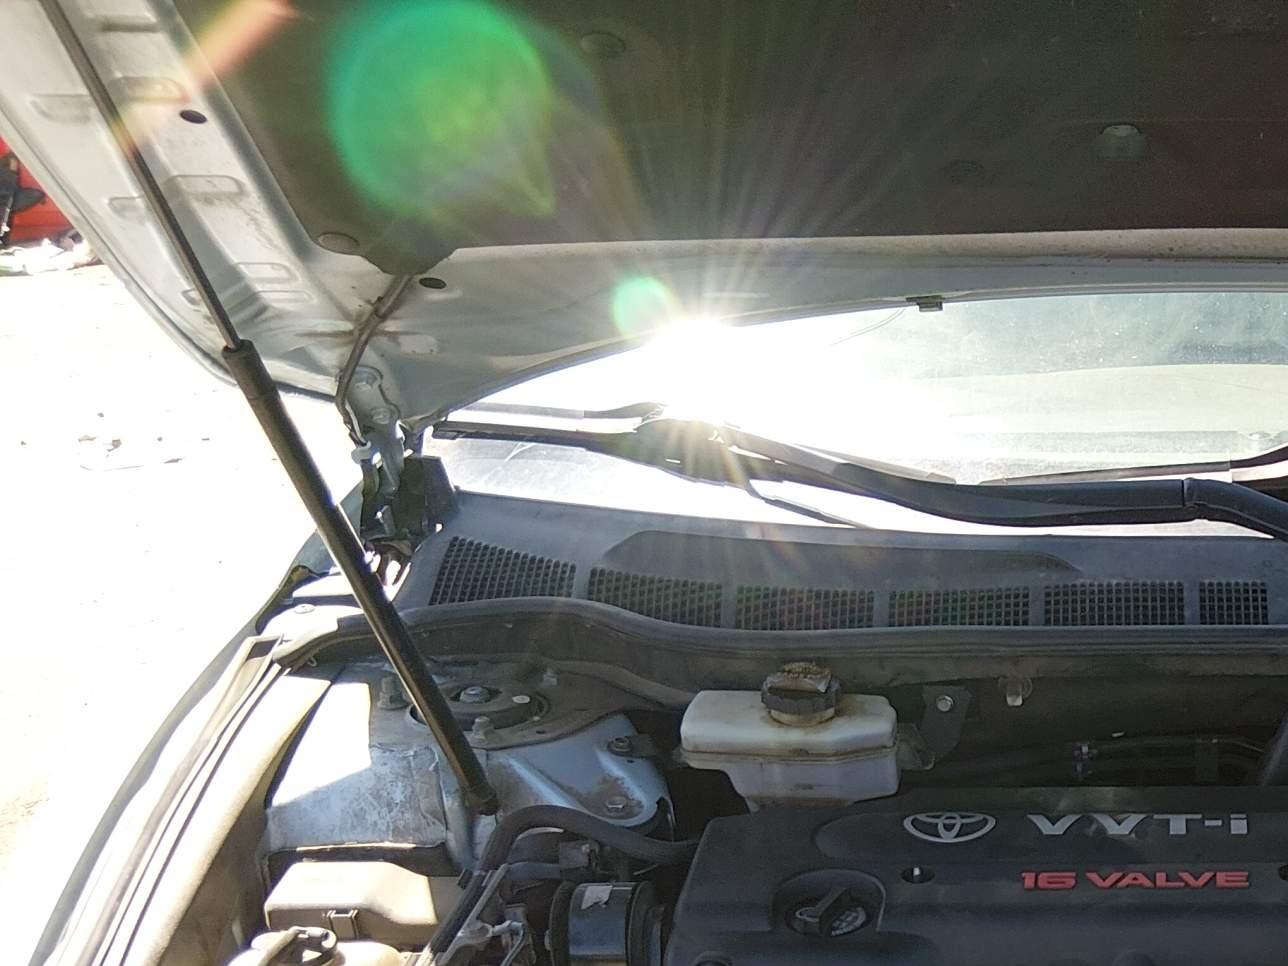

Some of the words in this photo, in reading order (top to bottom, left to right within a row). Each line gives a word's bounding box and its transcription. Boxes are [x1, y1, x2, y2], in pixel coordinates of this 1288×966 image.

[1027, 813, 1249, 836] VVT-i
[1021, 871, 1077, 890] 16
[1085, 871, 1250, 889] VALVE
